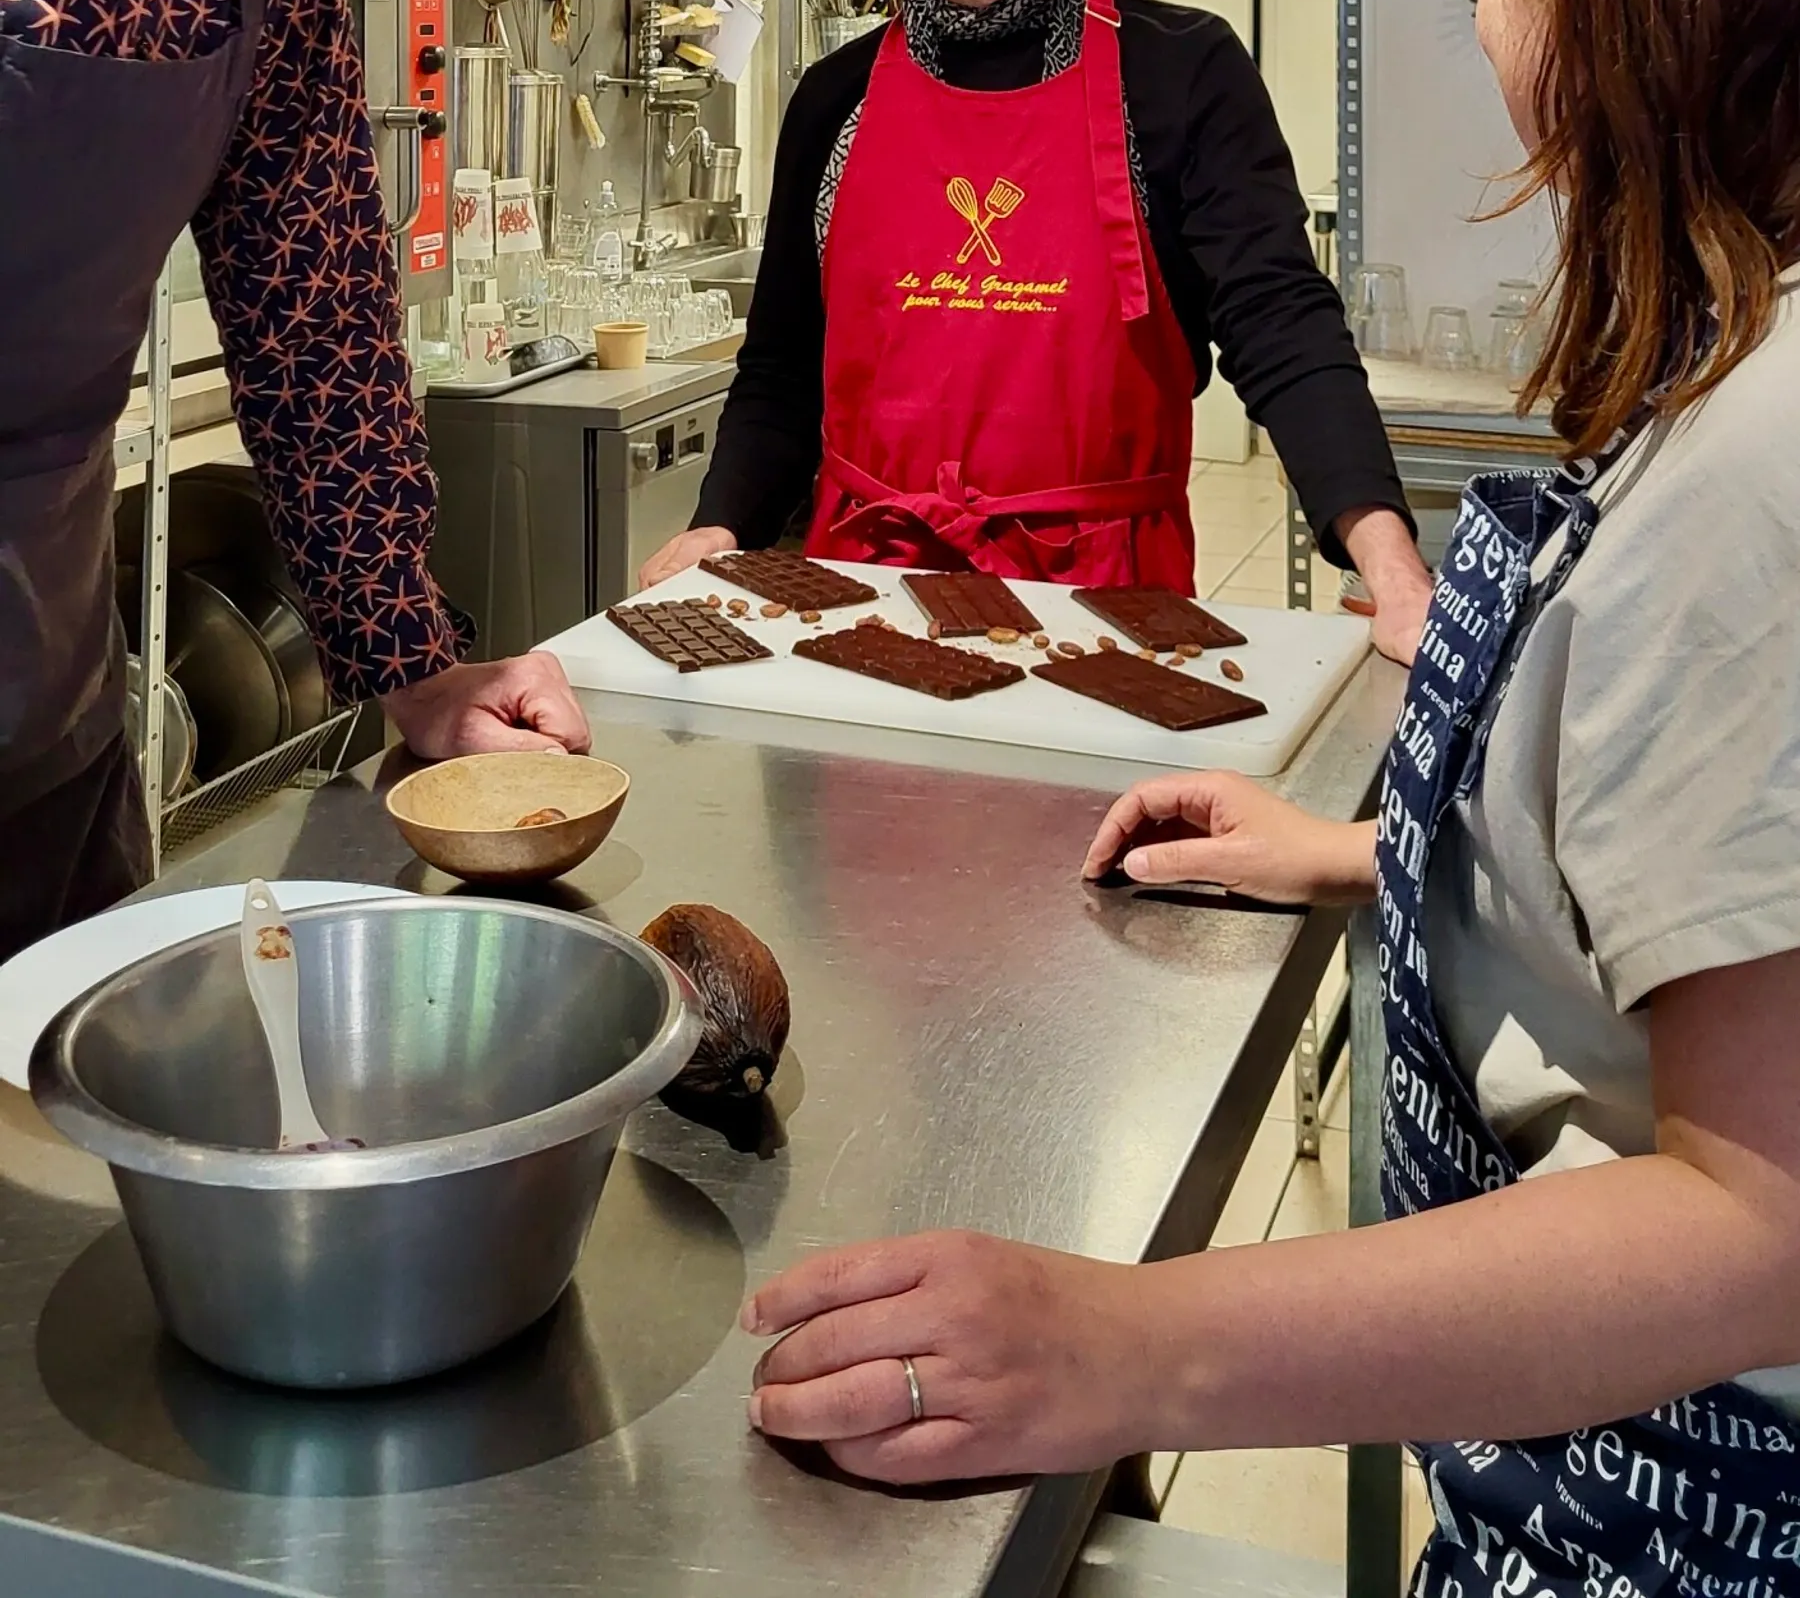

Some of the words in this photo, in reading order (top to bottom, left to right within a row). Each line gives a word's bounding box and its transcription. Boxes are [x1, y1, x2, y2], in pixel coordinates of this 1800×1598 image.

[895, 271, 921, 288] Le
[930, 272, 972, 295] Chef
[902, 294, 942, 312] pour
[948, 297, 985, 309] vous
[1396, 701, 1440, 781] tina
